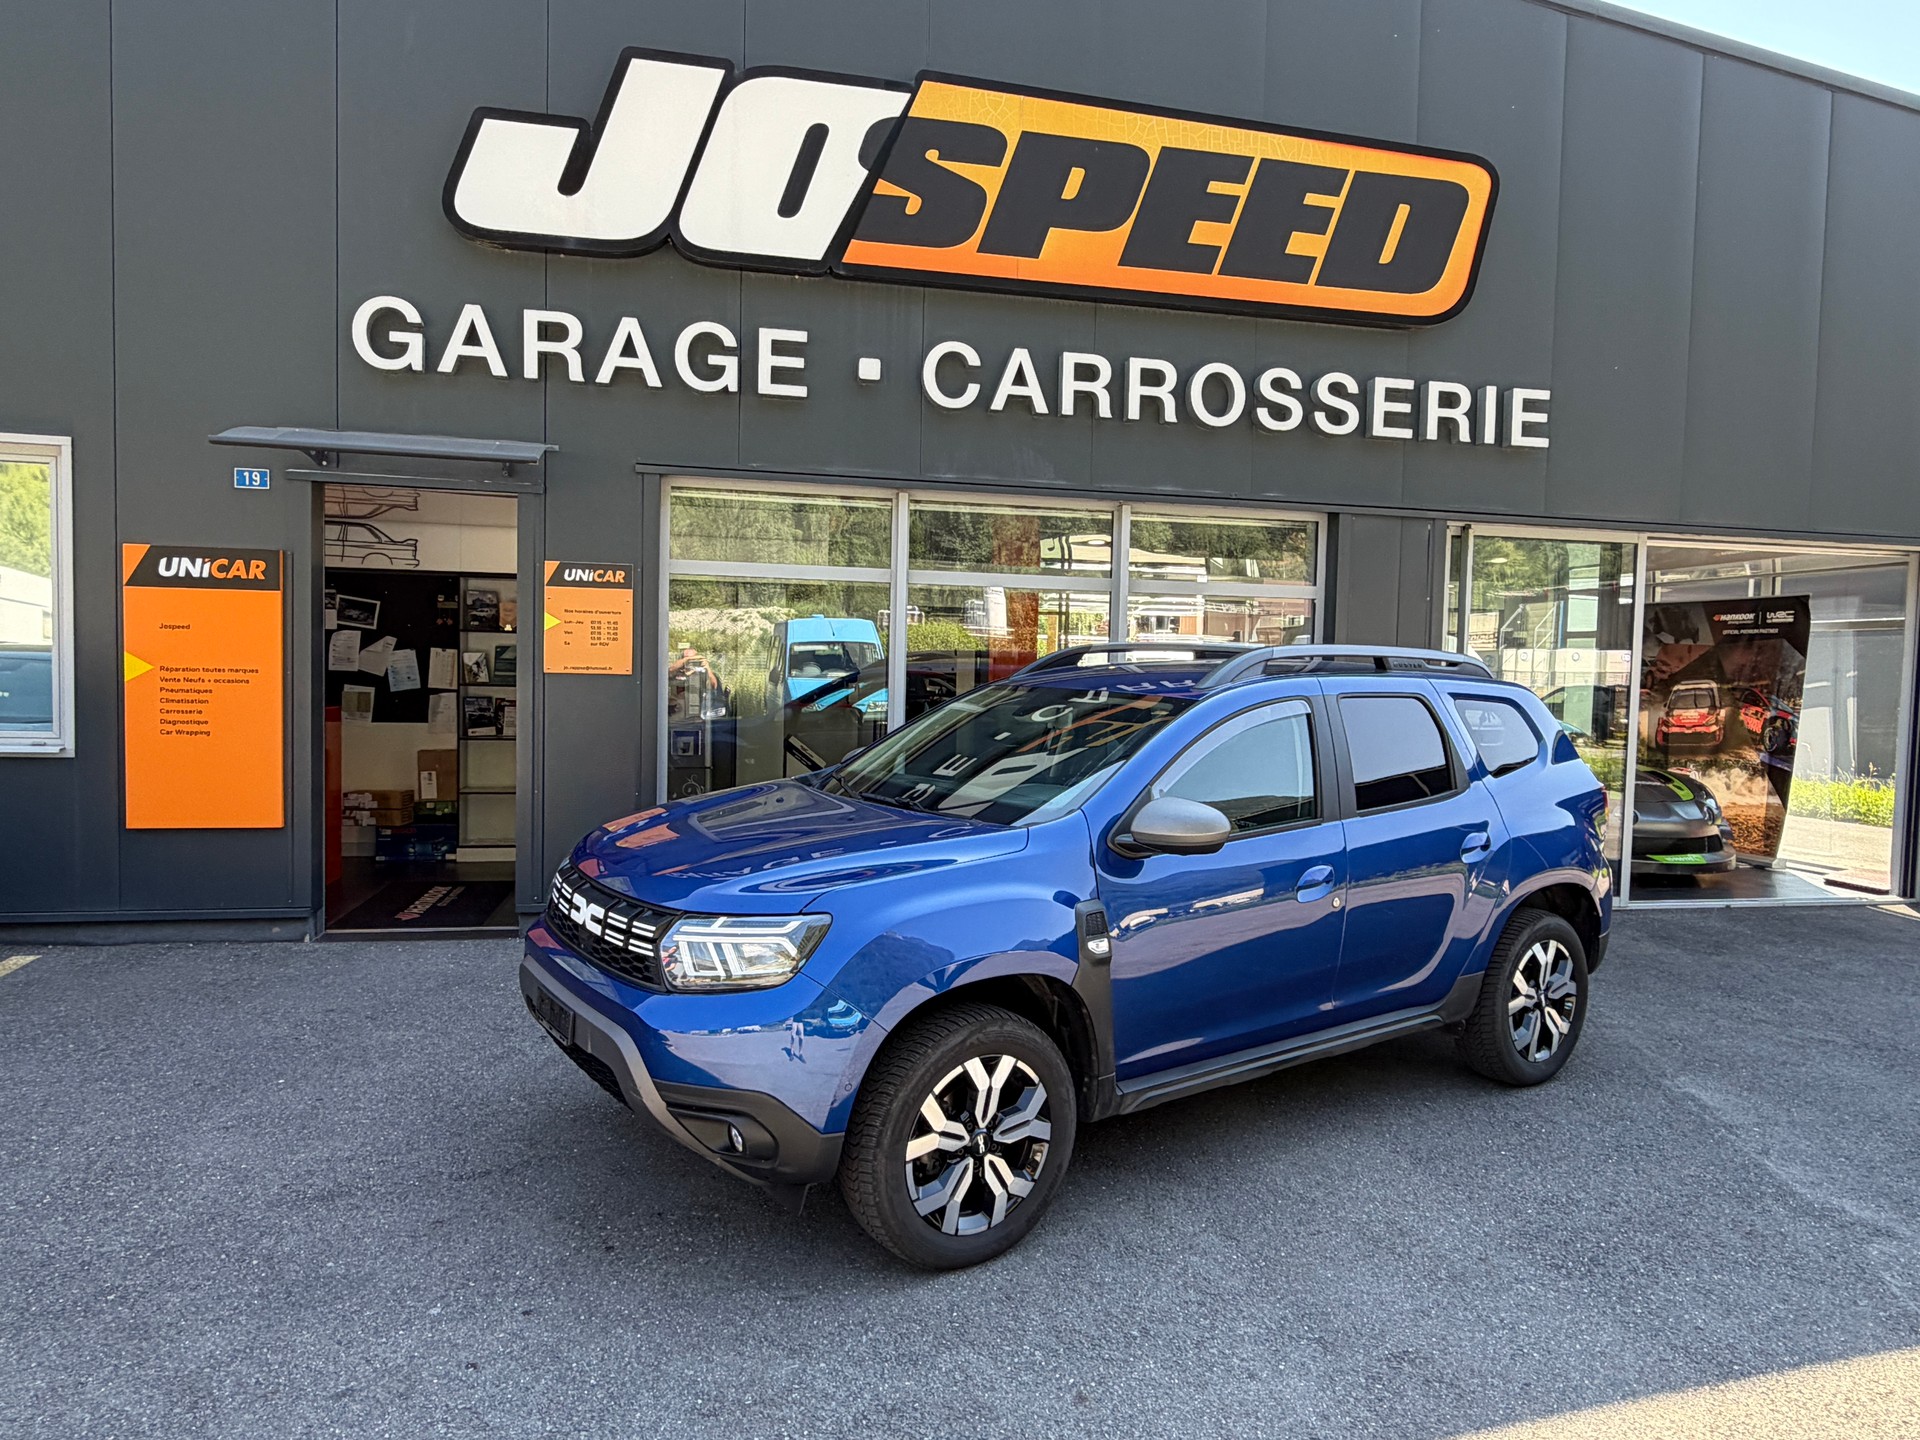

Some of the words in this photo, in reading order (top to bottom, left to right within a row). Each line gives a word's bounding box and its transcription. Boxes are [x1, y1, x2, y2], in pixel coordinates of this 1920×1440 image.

[352, 295, 809, 398] GARAGE
[921, 340, 1551, 449] CARROSSERIE
[243, 471, 260, 486] 19
[159, 623, 191, 631] Jospeed
[159, 665, 200, 673] Réparation
[159, 718, 209, 726] Diagnostique
[175, 729, 211, 737] Wrapping
